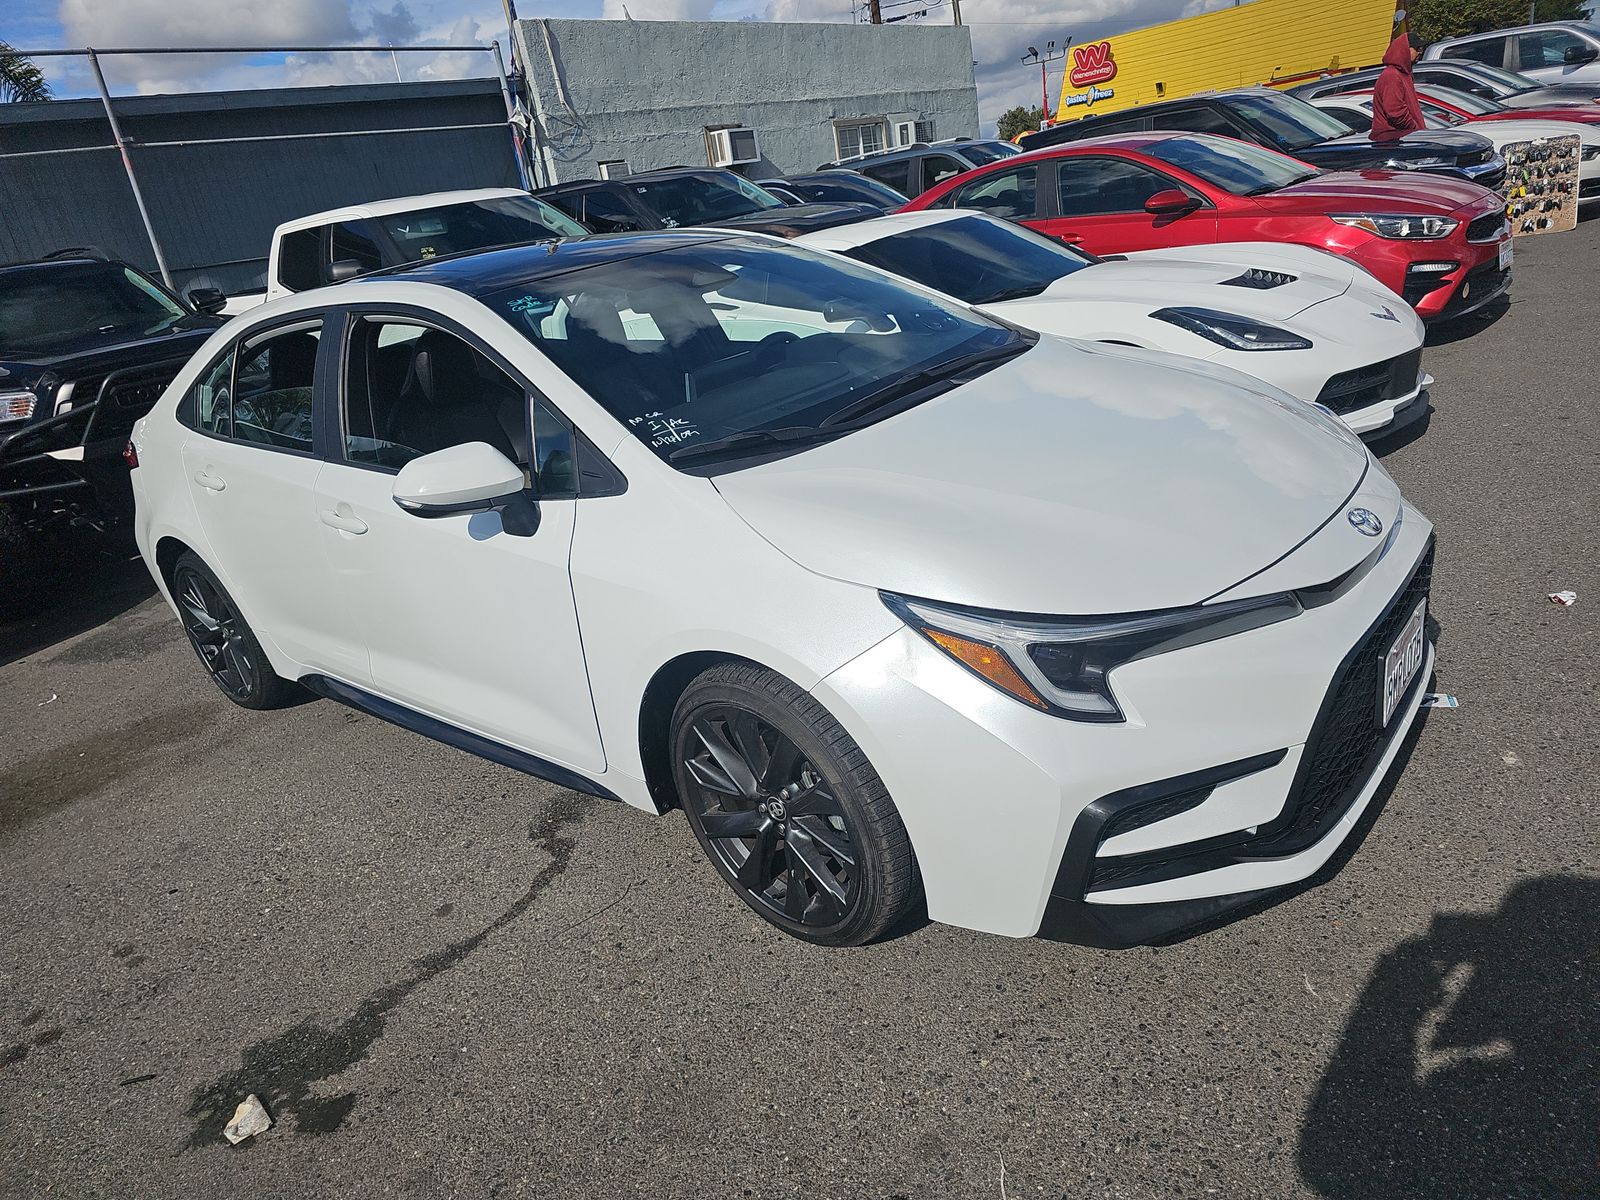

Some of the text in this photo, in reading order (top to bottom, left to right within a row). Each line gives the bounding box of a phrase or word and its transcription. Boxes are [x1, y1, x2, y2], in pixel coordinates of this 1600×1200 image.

[1074, 42, 1108, 71] W
[1066, 88, 1113, 106] tastee freez
